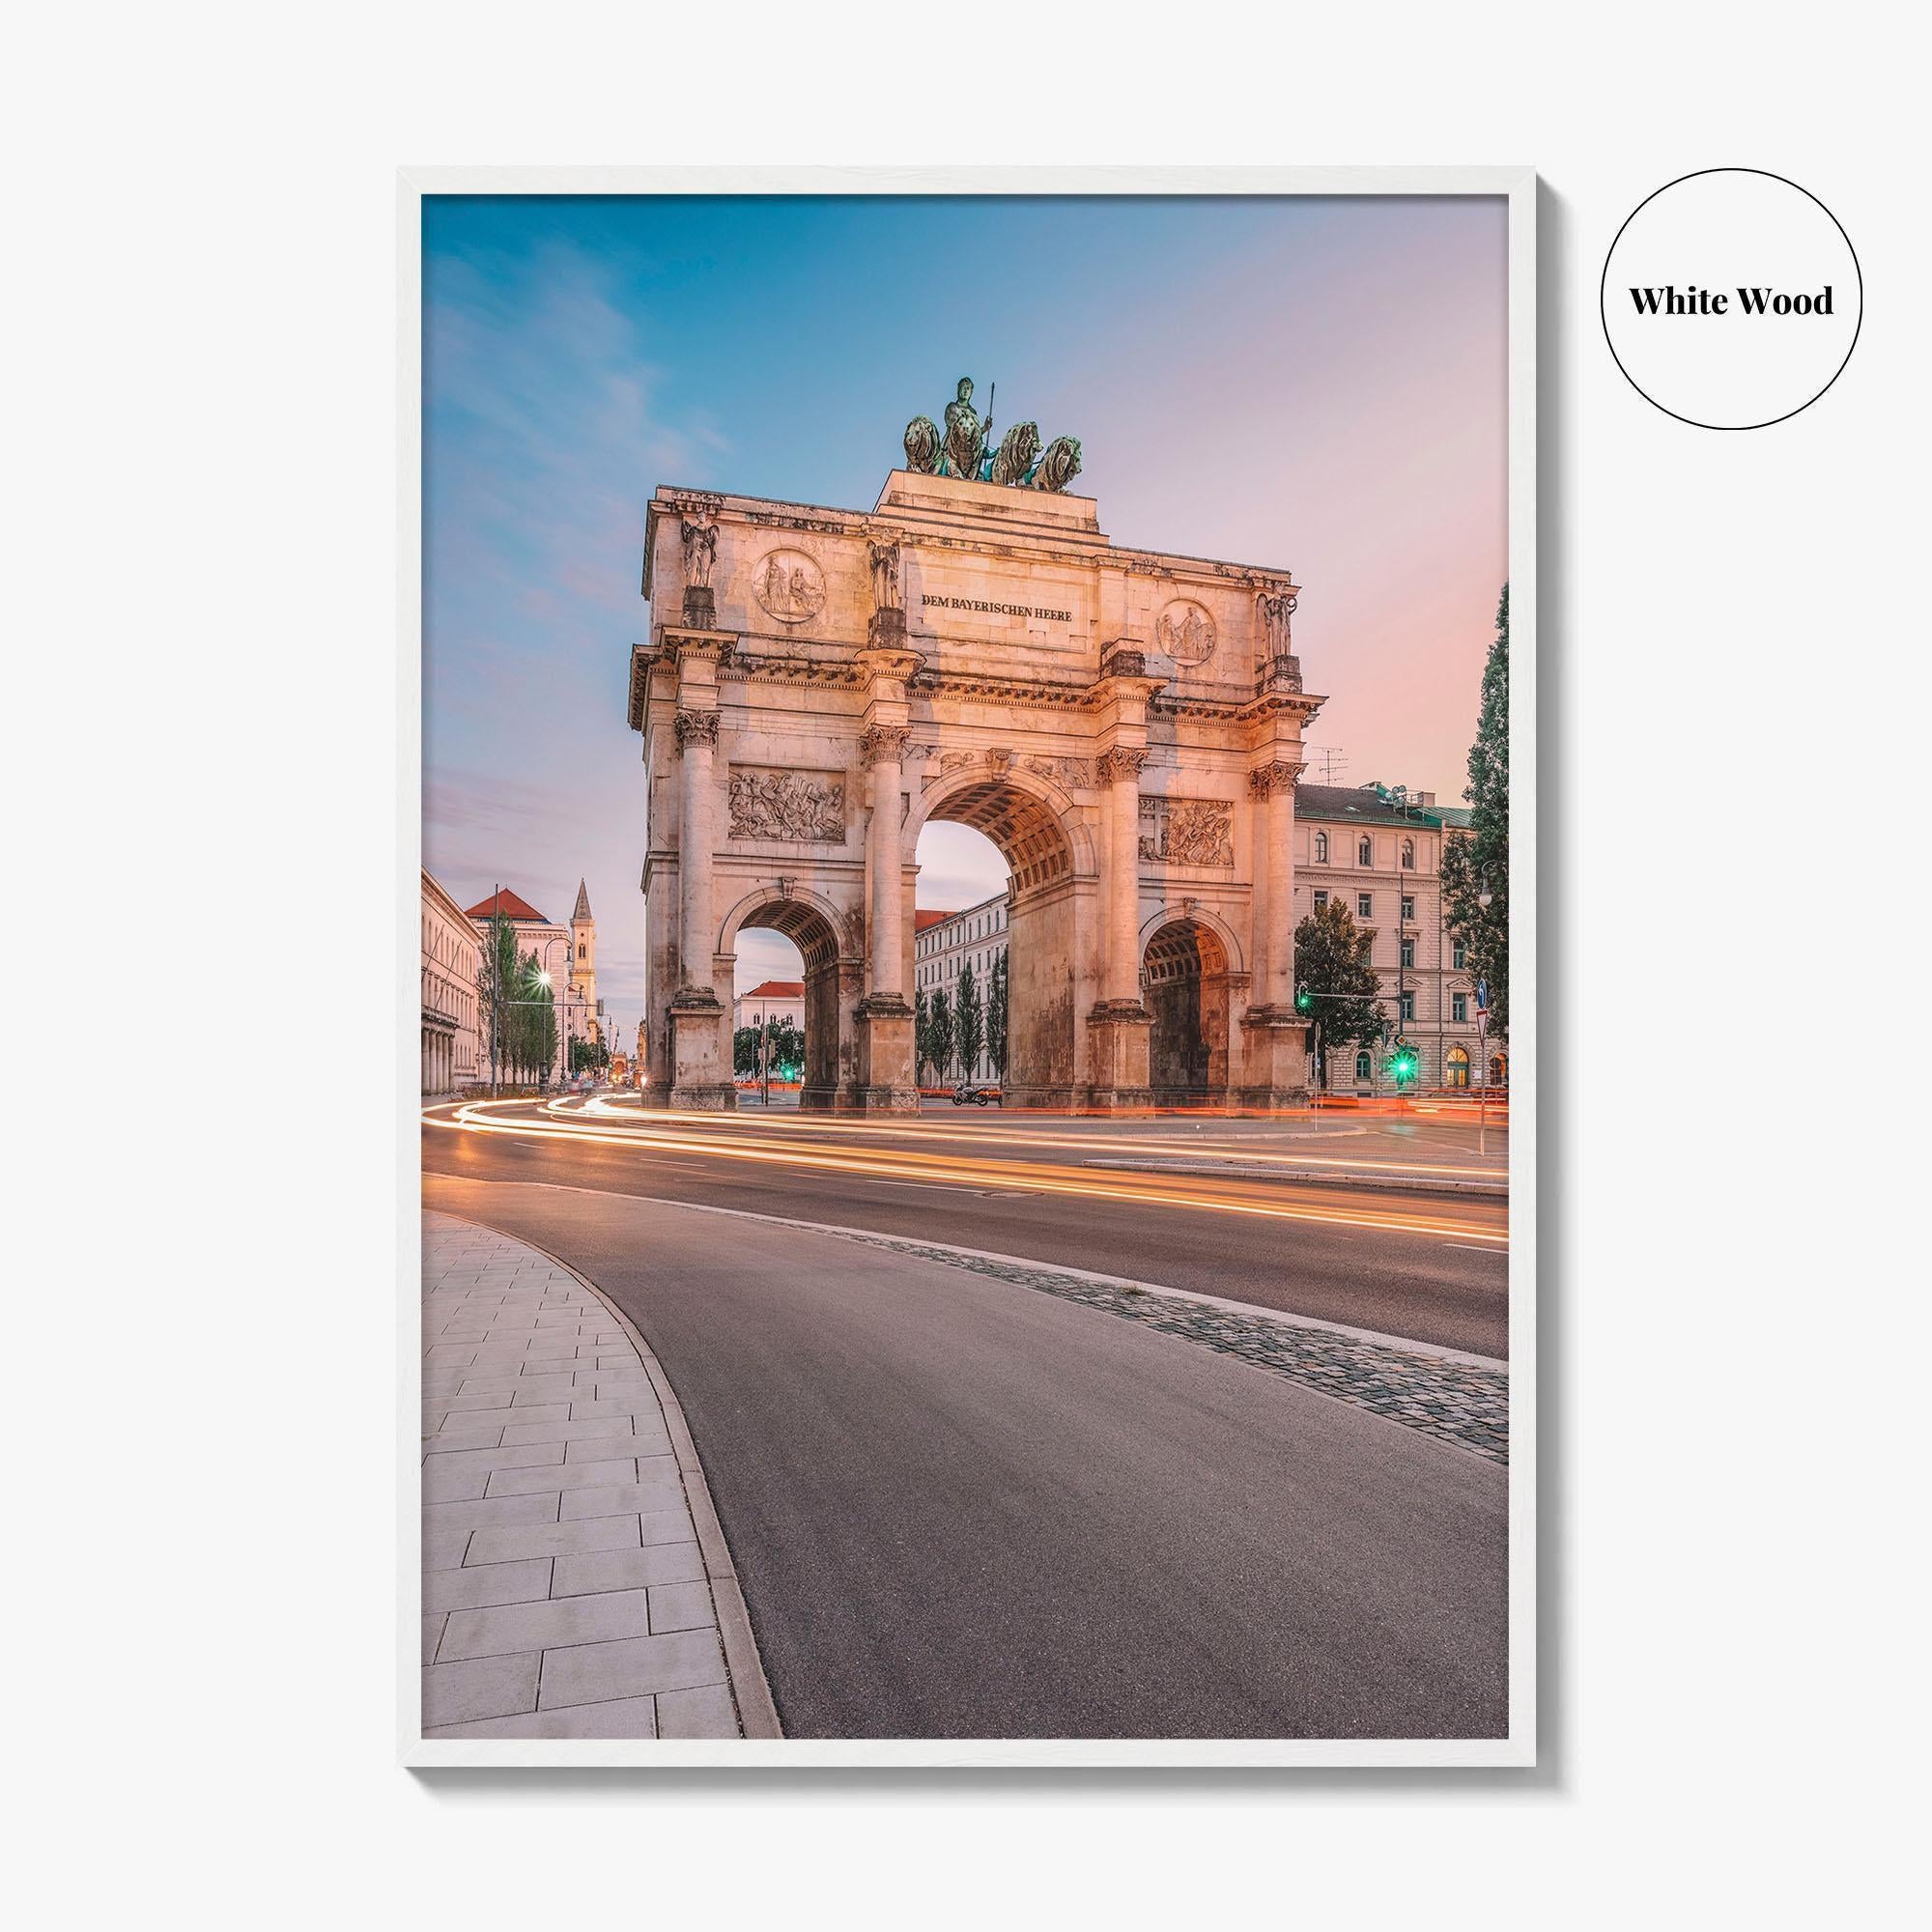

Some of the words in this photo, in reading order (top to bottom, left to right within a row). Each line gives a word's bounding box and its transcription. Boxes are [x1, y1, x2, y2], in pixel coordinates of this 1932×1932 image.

[922, 594, 950, 609] DEM
[952, 598, 1033, 617] BAYERISCHEN
[1035, 608, 1072, 622] HEERE
